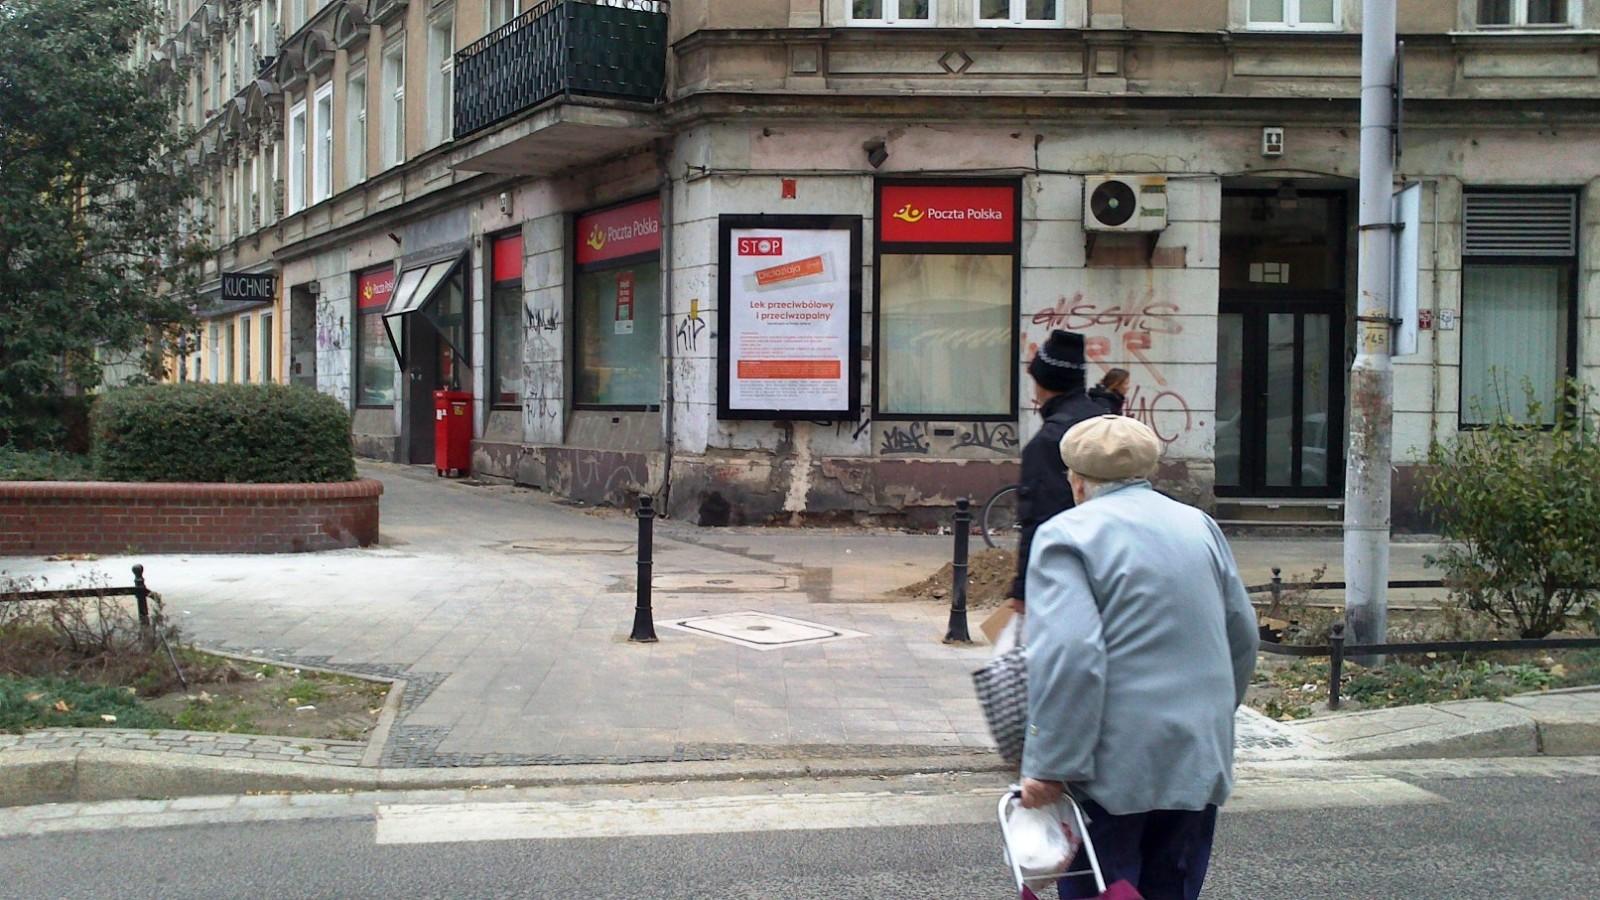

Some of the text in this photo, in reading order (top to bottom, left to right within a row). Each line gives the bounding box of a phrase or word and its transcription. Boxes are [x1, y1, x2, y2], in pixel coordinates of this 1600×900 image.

[928, 207, 1003, 220] Poczta Polska
[607, 217, 658, 242] Poczta Polska
[740, 239, 780, 254] STOP
[224, 277, 270, 297] KUCHNIE
[750, 300, 765, 309] Lek
[761, 311, 831, 321] przeciwzapalny
